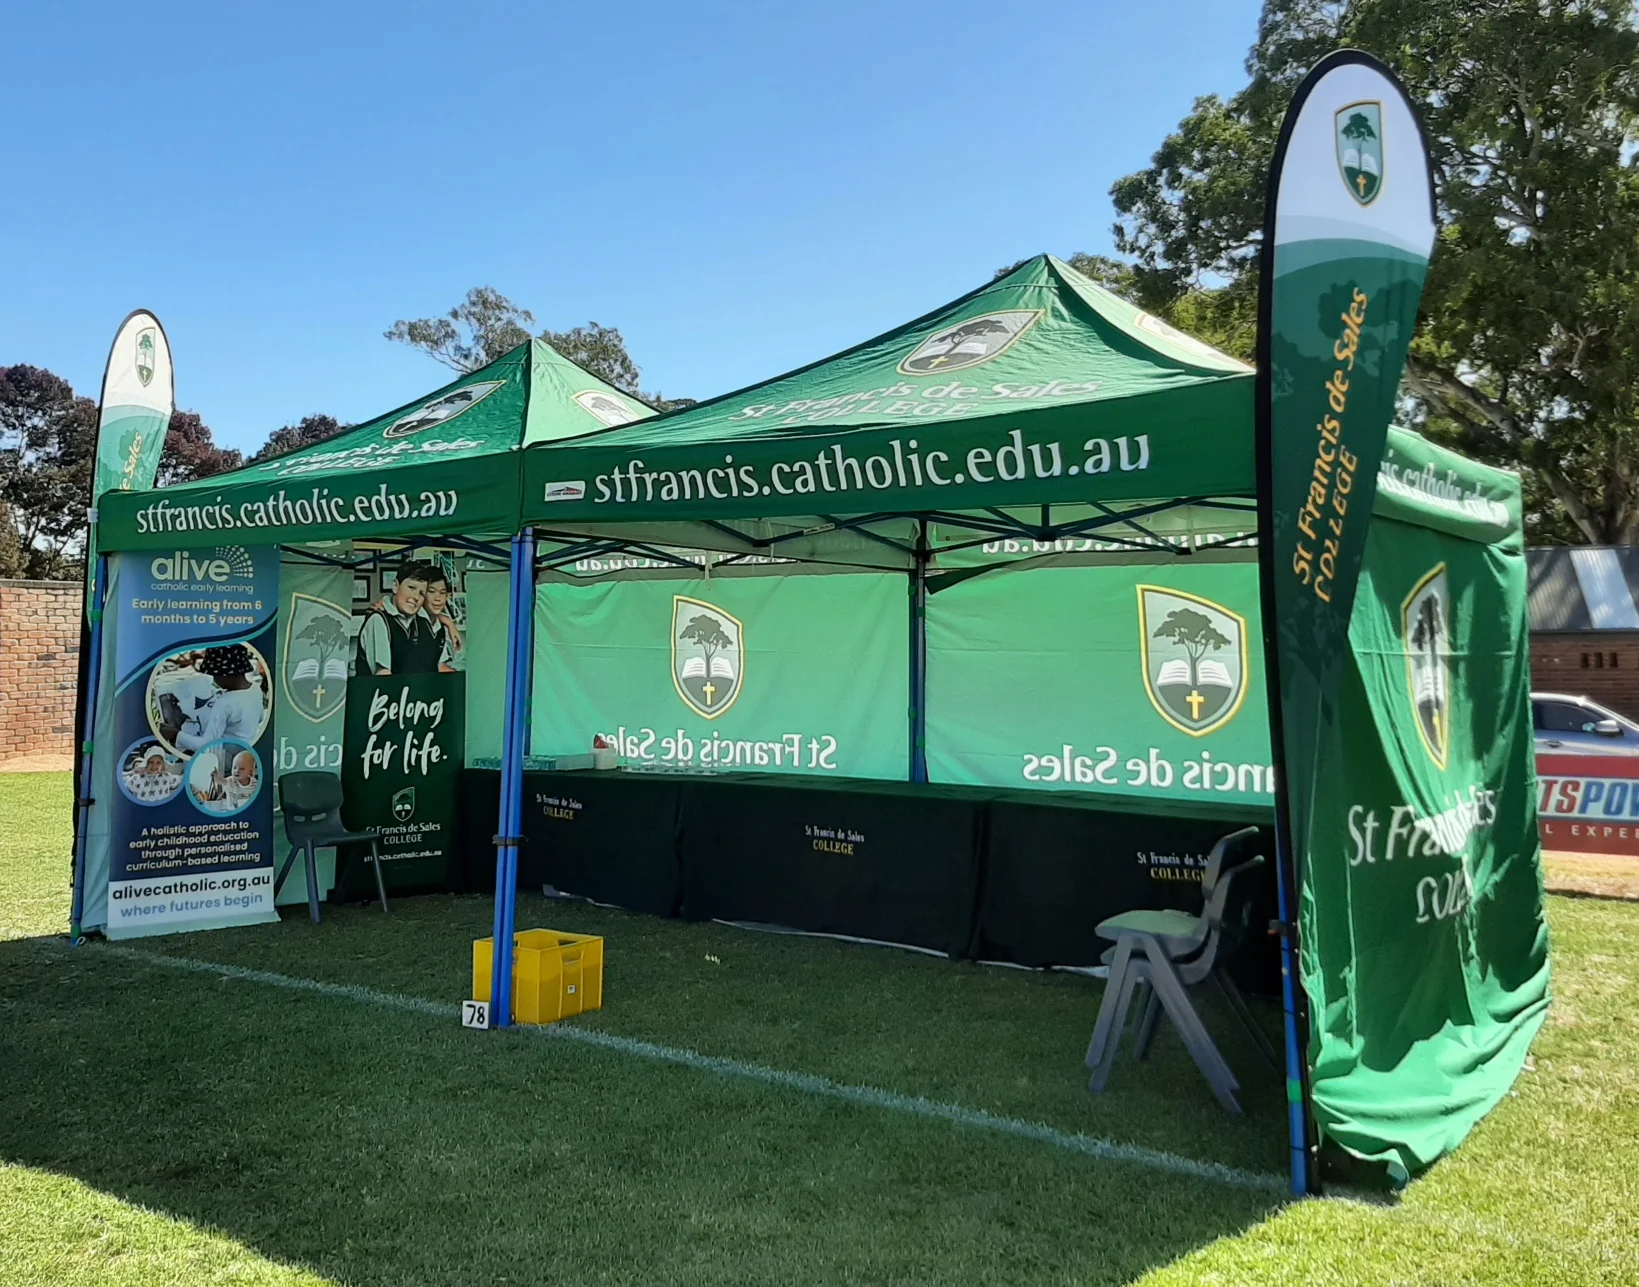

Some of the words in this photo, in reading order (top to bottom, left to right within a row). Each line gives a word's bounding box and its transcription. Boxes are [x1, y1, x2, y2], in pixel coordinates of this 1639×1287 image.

[1333, 287, 1368, 371] Sales
[728, 403, 779, 422] St
[774, 381, 917, 415] Francis
[921, 382, 979, 400] de
[981, 379, 1103, 400] Sales
[1325, 369, 1350, 414] de
[782, 399, 979, 425] COLLEGE
[124, 432, 142, 479] Sales
[594, 429, 1151, 503] stfrancis.catholic.edu.au
[1297, 413, 1341, 541] Francis
[136, 483, 458, 534] stfrancis.catholic.edu.au
[1314, 444, 1358, 603] COLLEGE
[151, 550, 231, 582] alive
[1293, 542, 1314, 585] St
[151, 582, 189, 592] catholic
[190, 583, 215, 594] early
[216, 583, 254, 595] learning
[132, 598, 166, 612] Early
[167, 598, 220, 613] learning
[222, 600, 252, 610] from
[255, 600, 263, 610] 6
[141, 613, 191, 624] months
[193, 614, 206, 624] to
[208, 614, 217, 624] 5
[219, 615, 254, 627] years
[368, 686, 444, 733] Belong
[361, 734, 398, 780] for
[403, 731, 448, 776] life.
[1536, 779, 1639, 817] TSPO
[129, 837, 156, 850] early
[157, 835, 208, 847] childhood
[209, 831, 260, 842] education
[141, 828, 149, 837] A
[150, 824, 187, 836] holistic
[188, 821, 237, 835] approach
[238, 821, 250, 830] to
[376, 824, 407, 835] Francis
[408, 823, 419, 833] de
[420, 822, 441, 832] Sales
[383, 833, 423, 845] COLLEGE
[1348, 804, 1381, 867] St
[126, 856, 219, 872] curriculum-based
[220, 852, 261, 864] learning
[141, 847, 183, 859] through
[184, 842, 248, 857] personalised
[813, 839, 854, 856] COLLEGE
[112, 875, 271, 900] alivecatholic.org.au
[120, 904, 167, 918] where
[169, 897, 221, 913] futures
[224, 892, 263, 909] begin
[465, 1004, 486, 1025] 78
